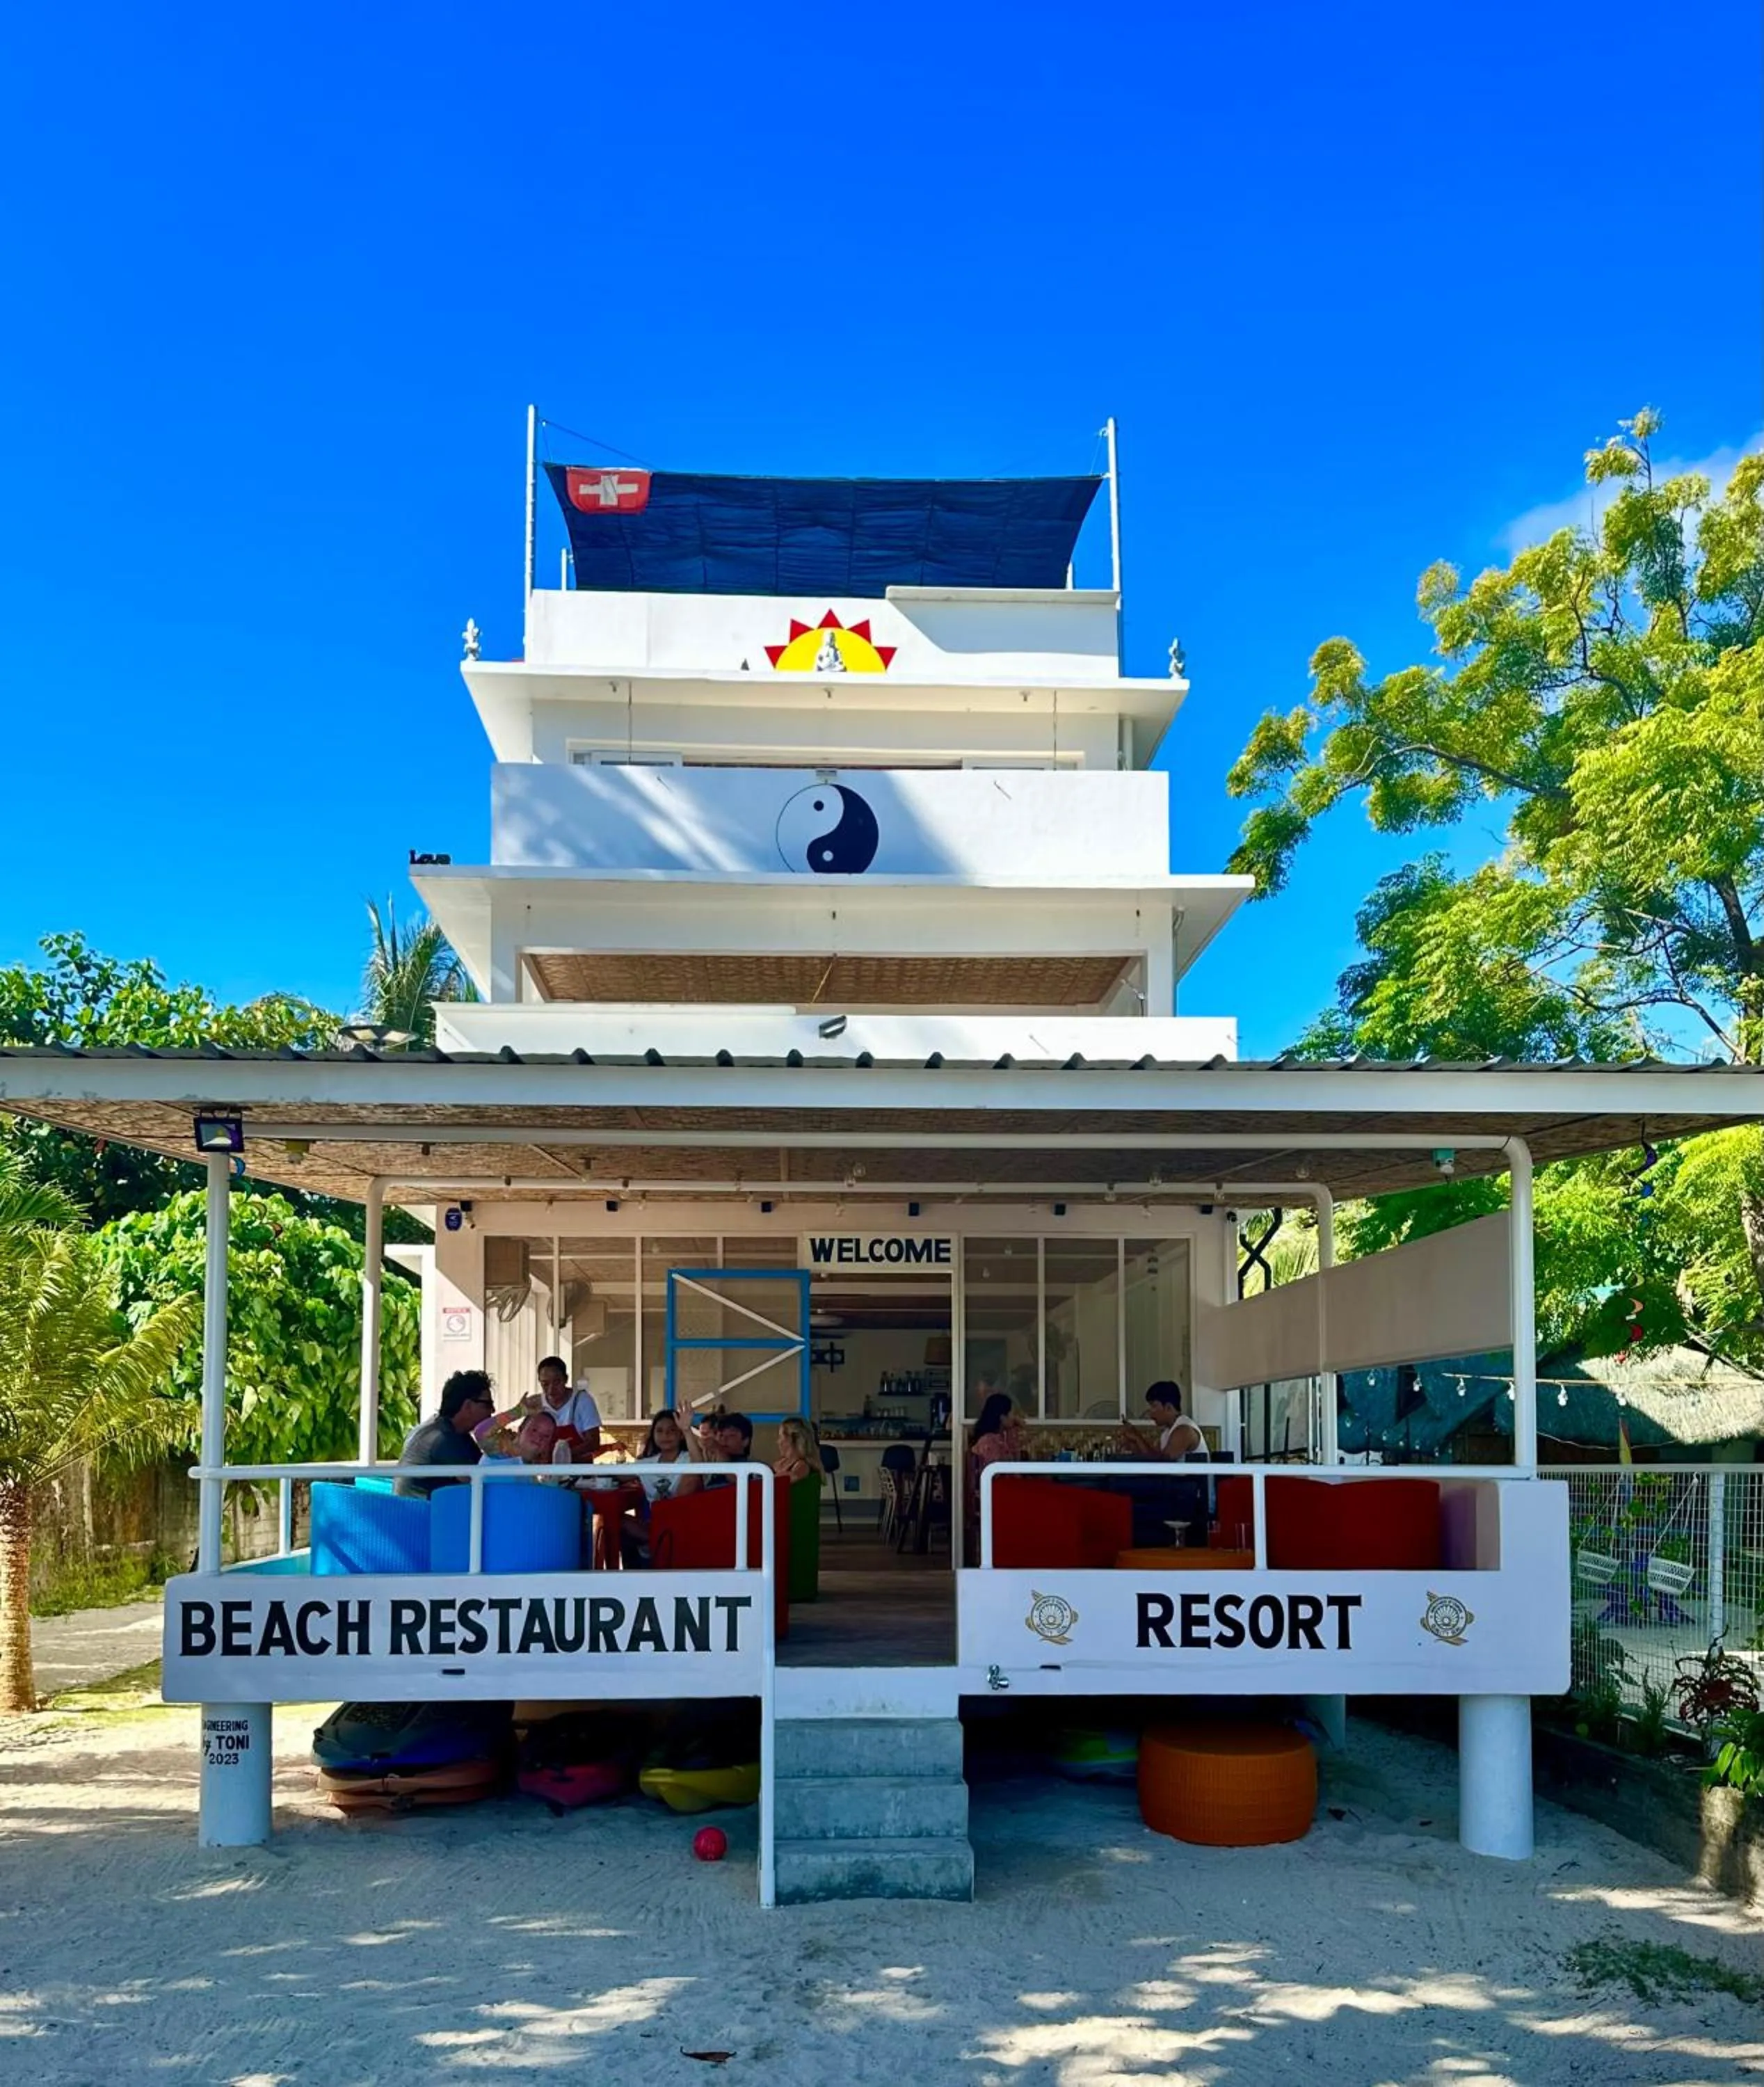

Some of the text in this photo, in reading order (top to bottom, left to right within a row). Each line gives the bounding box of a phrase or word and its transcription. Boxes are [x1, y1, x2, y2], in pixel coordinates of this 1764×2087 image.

[809, 1237, 952, 1263] WELCOME
[178, 1595, 753, 1657] BEACH RESTAURANT
[1135, 1592, 1363, 1651] RESORT
[215, 1734, 250, 1751] TONI
[209, 1752, 240, 1766] 2023
